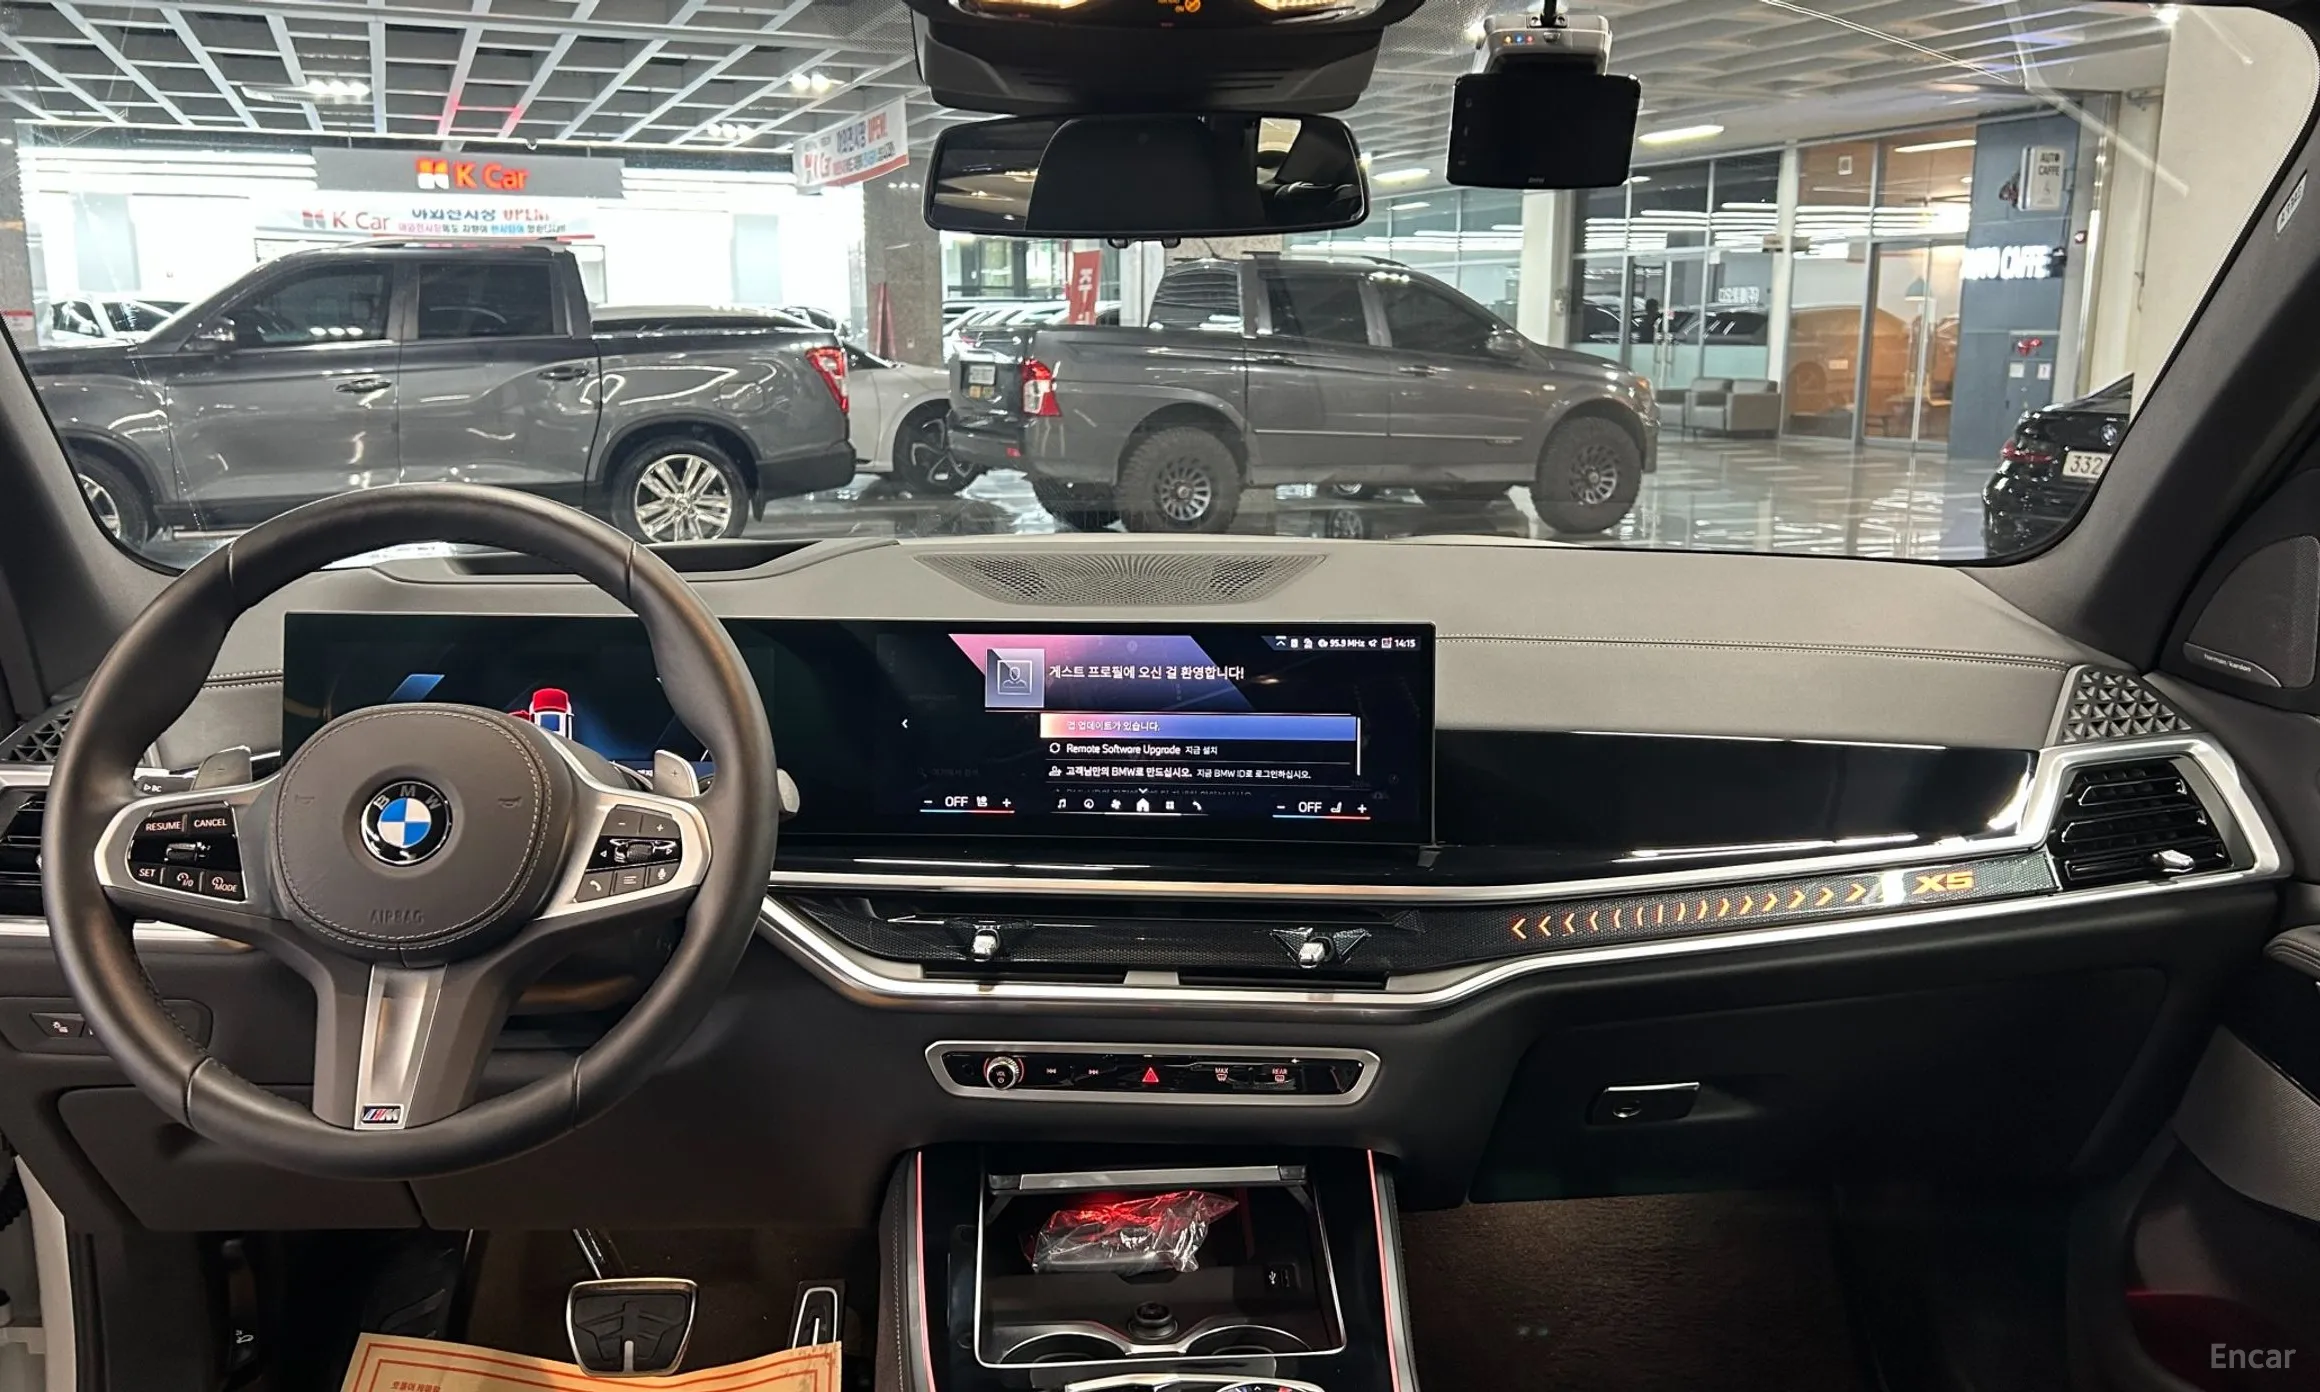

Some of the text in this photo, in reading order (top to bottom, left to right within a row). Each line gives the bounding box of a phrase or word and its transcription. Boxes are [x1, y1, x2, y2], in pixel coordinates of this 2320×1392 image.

[455, 161, 530, 190] K Car
[333, 211, 350, 230] K
[355, 211, 391, 231] Car
[1394, 639, 1417, 648] 14:15
[1049, 665, 1245, 681] 게스트 프로필에 오신 걸 환영합니다!
[1077, 721, 1121, 732] 업데이트가
[1123, 721, 1160, 732] 있습니다.
[1066, 743, 1218, 756] Remote Software Upgrade 지금 설치
[1066, 766, 1312, 780] 고객님만의 BMW로 만드십시오. 지금 BMW ID로 로그인하십시오.
[374, 784, 441, 812] BMW
[945, 796, 969, 808] OFF
[1298, 801, 1323, 814] OFF
[145, 821, 182, 832] RESUME
[193, 818, 228, 829] CANCEL
[138, 868, 156, 878] SET
[213, 882, 238, 893] MODE
[1912, 870, 1974, 896] X5
[370, 907, 425, 926] AIRBAG
[1214, 1066, 1230, 1075] MAX
